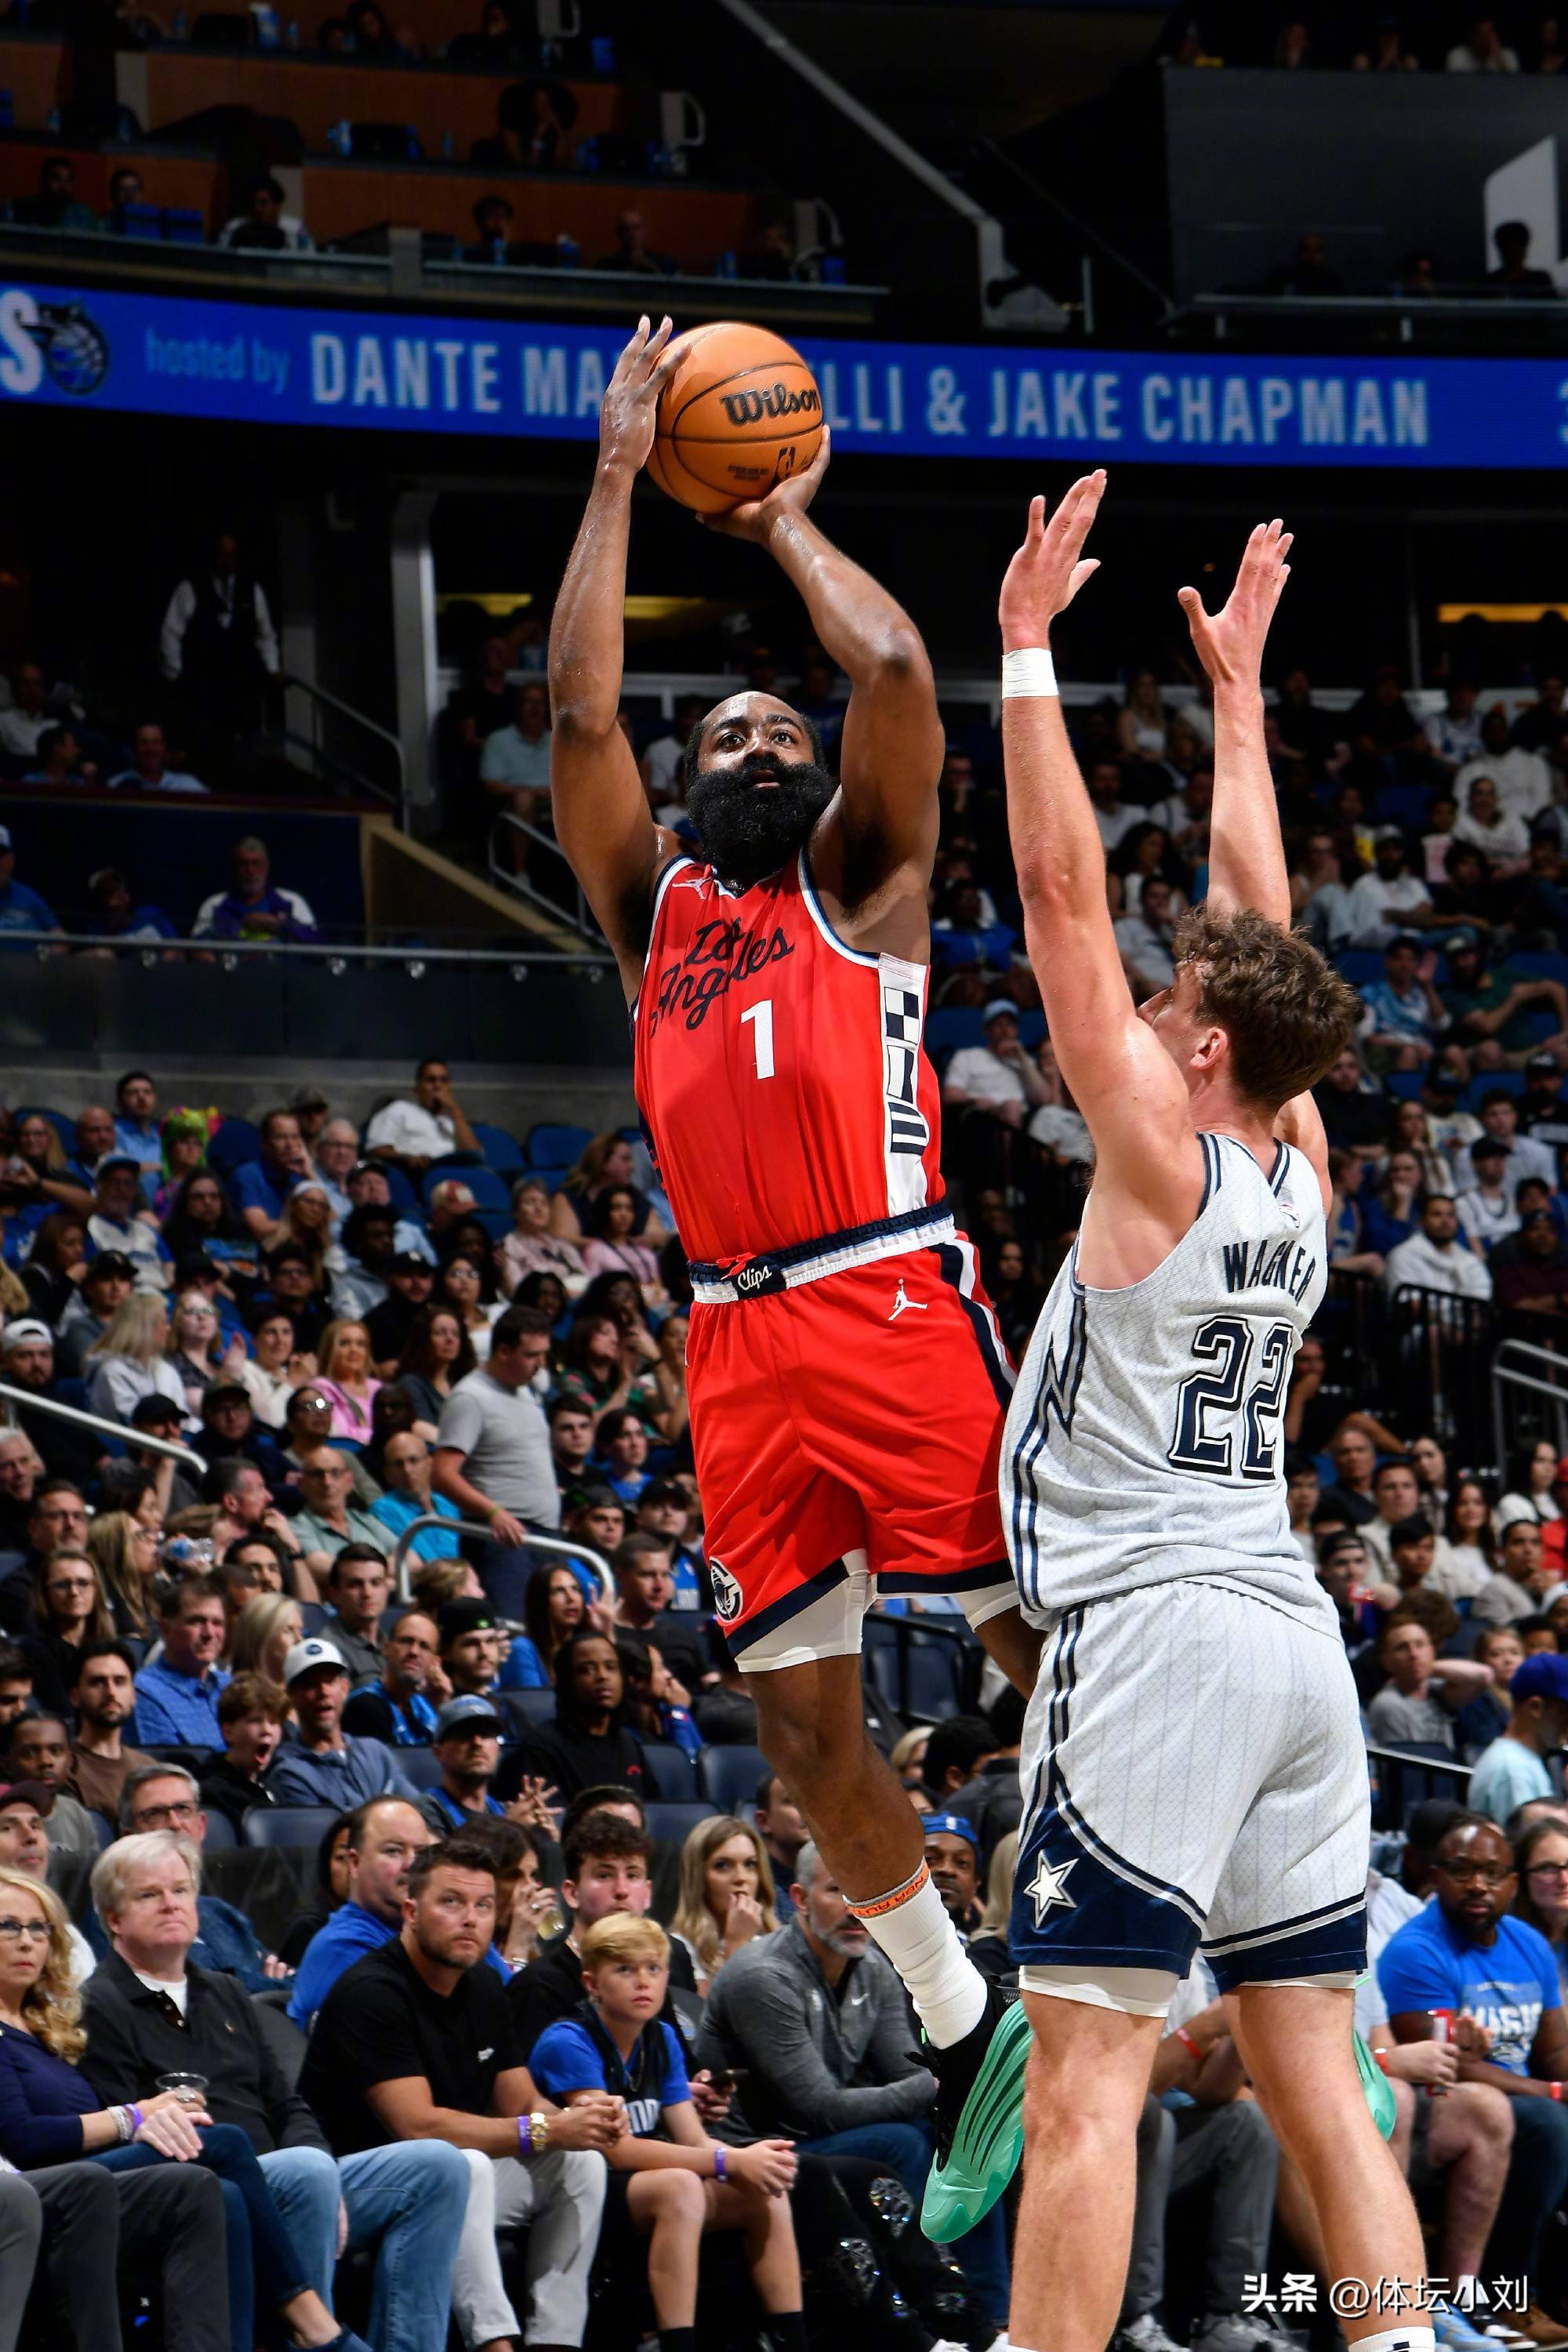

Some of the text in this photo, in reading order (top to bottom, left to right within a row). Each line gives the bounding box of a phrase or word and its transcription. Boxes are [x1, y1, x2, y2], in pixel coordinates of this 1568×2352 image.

[146, 327, 245, 381] hosted
[252, 337, 291, 395] by
[311, 333, 503, 414] DANTE
[926, 368, 968, 437] &
[987, 370, 1122, 441] JAKE
[1142, 374, 1429, 447] CHAPMAN
[720, 382, 822, 426] Wilson
[740, 1000, 775, 1080] 1
[737, 1265, 773, 1291] Clips
[1223, 1239, 1316, 1306] WAGNER
[1168, 1315, 1295, 1480] 22
[894, 1875, 924, 1903] NBA
